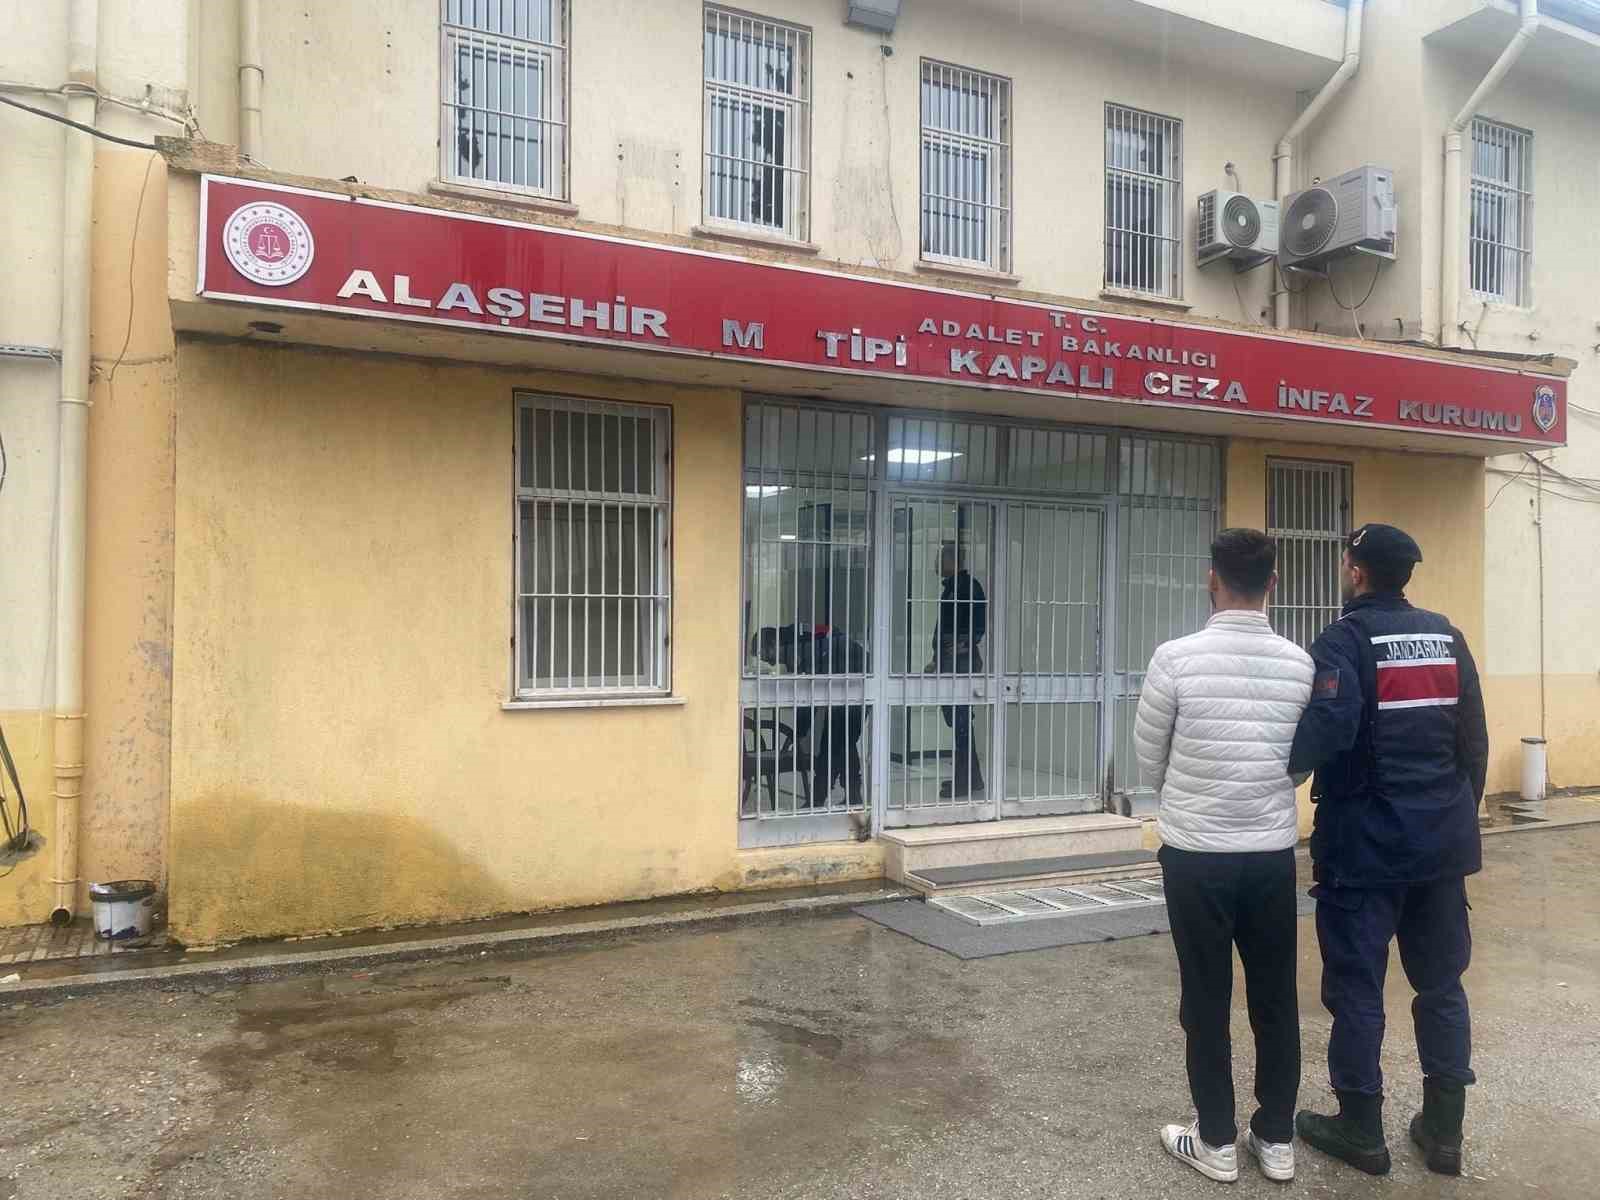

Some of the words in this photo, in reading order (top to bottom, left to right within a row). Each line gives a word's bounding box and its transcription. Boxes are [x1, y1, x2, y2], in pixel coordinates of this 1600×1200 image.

[918, 318, 1044, 346] ADALET
[337, 269, 669, 337] ALAŞEHİR
[722, 319, 764, 350] M
[817, 328, 907, 367] TİPİ
[951, 349, 1113, 389] KAPALI
[1144, 371, 1248, 403] CEZA
[1278, 380, 1374, 416] İNFAZ
[1400, 400, 1521, 432] KURUMU
[1387, 639, 1450, 660] JANDARMA
